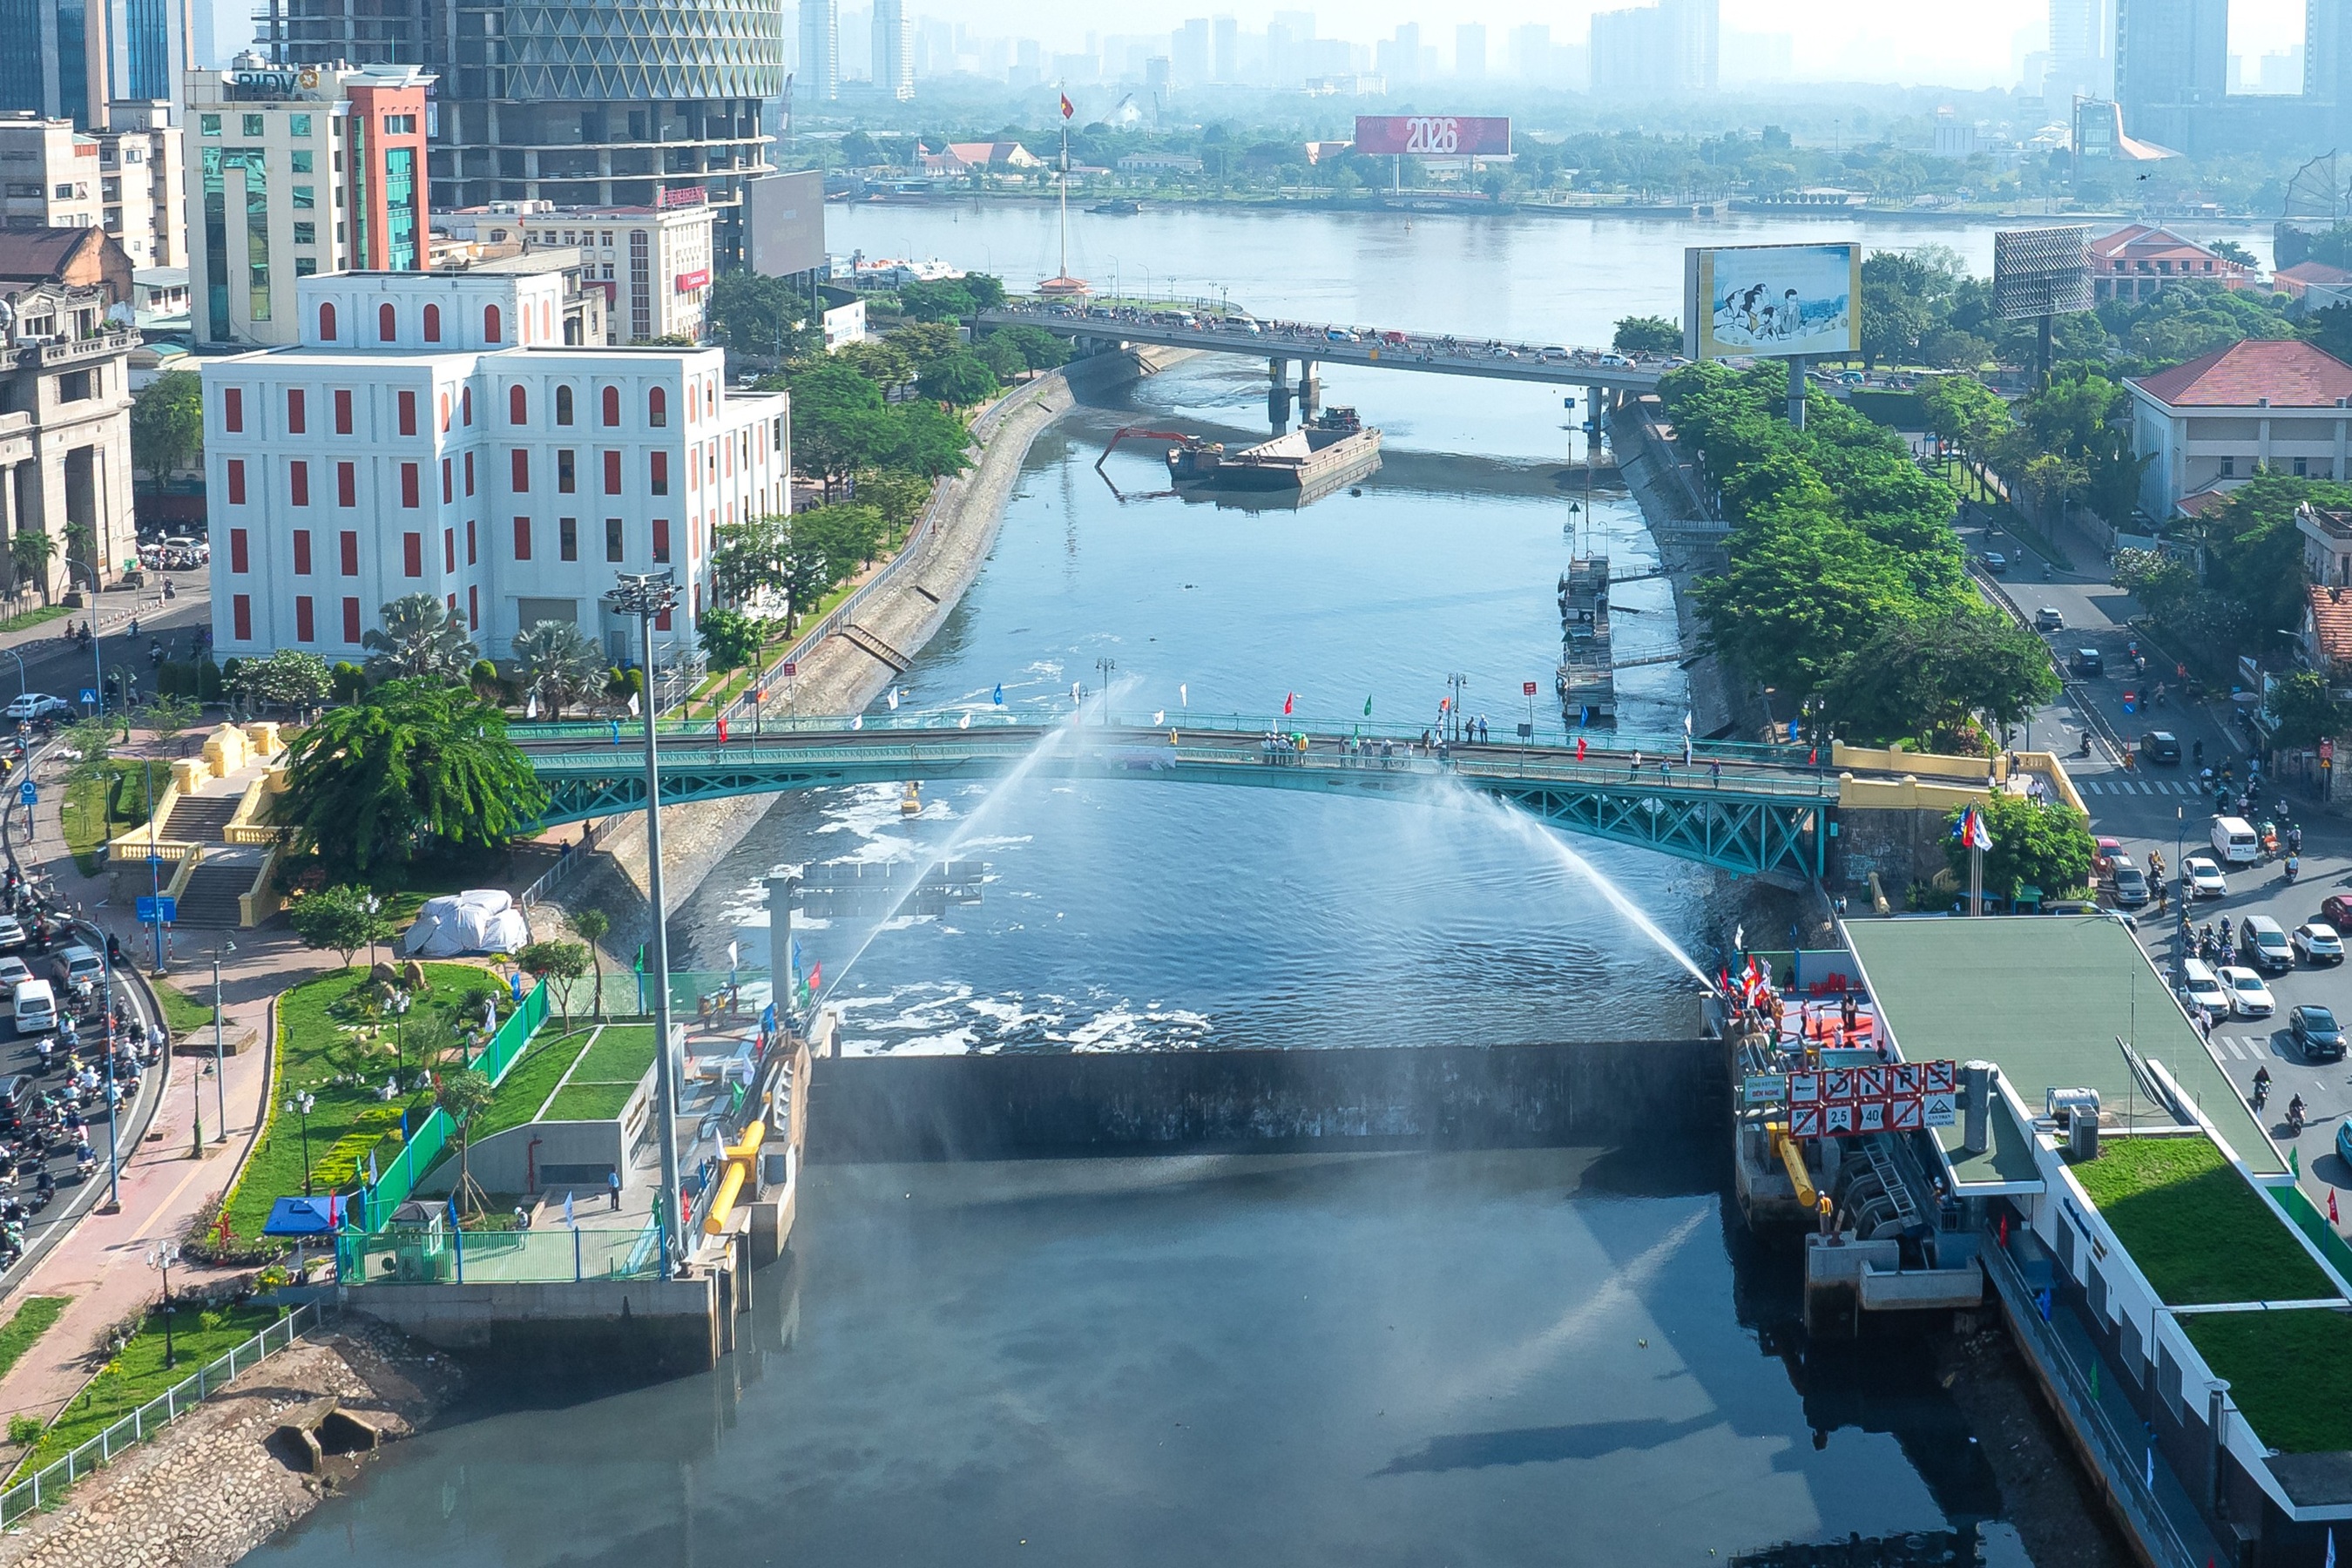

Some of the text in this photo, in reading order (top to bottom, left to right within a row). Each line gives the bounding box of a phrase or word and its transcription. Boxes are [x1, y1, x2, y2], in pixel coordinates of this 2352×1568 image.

[1406, 118, 1457, 153] 2026
[1830, 1110, 1847, 1124] 2.5
[1866, 1109, 1879, 1122] 40
